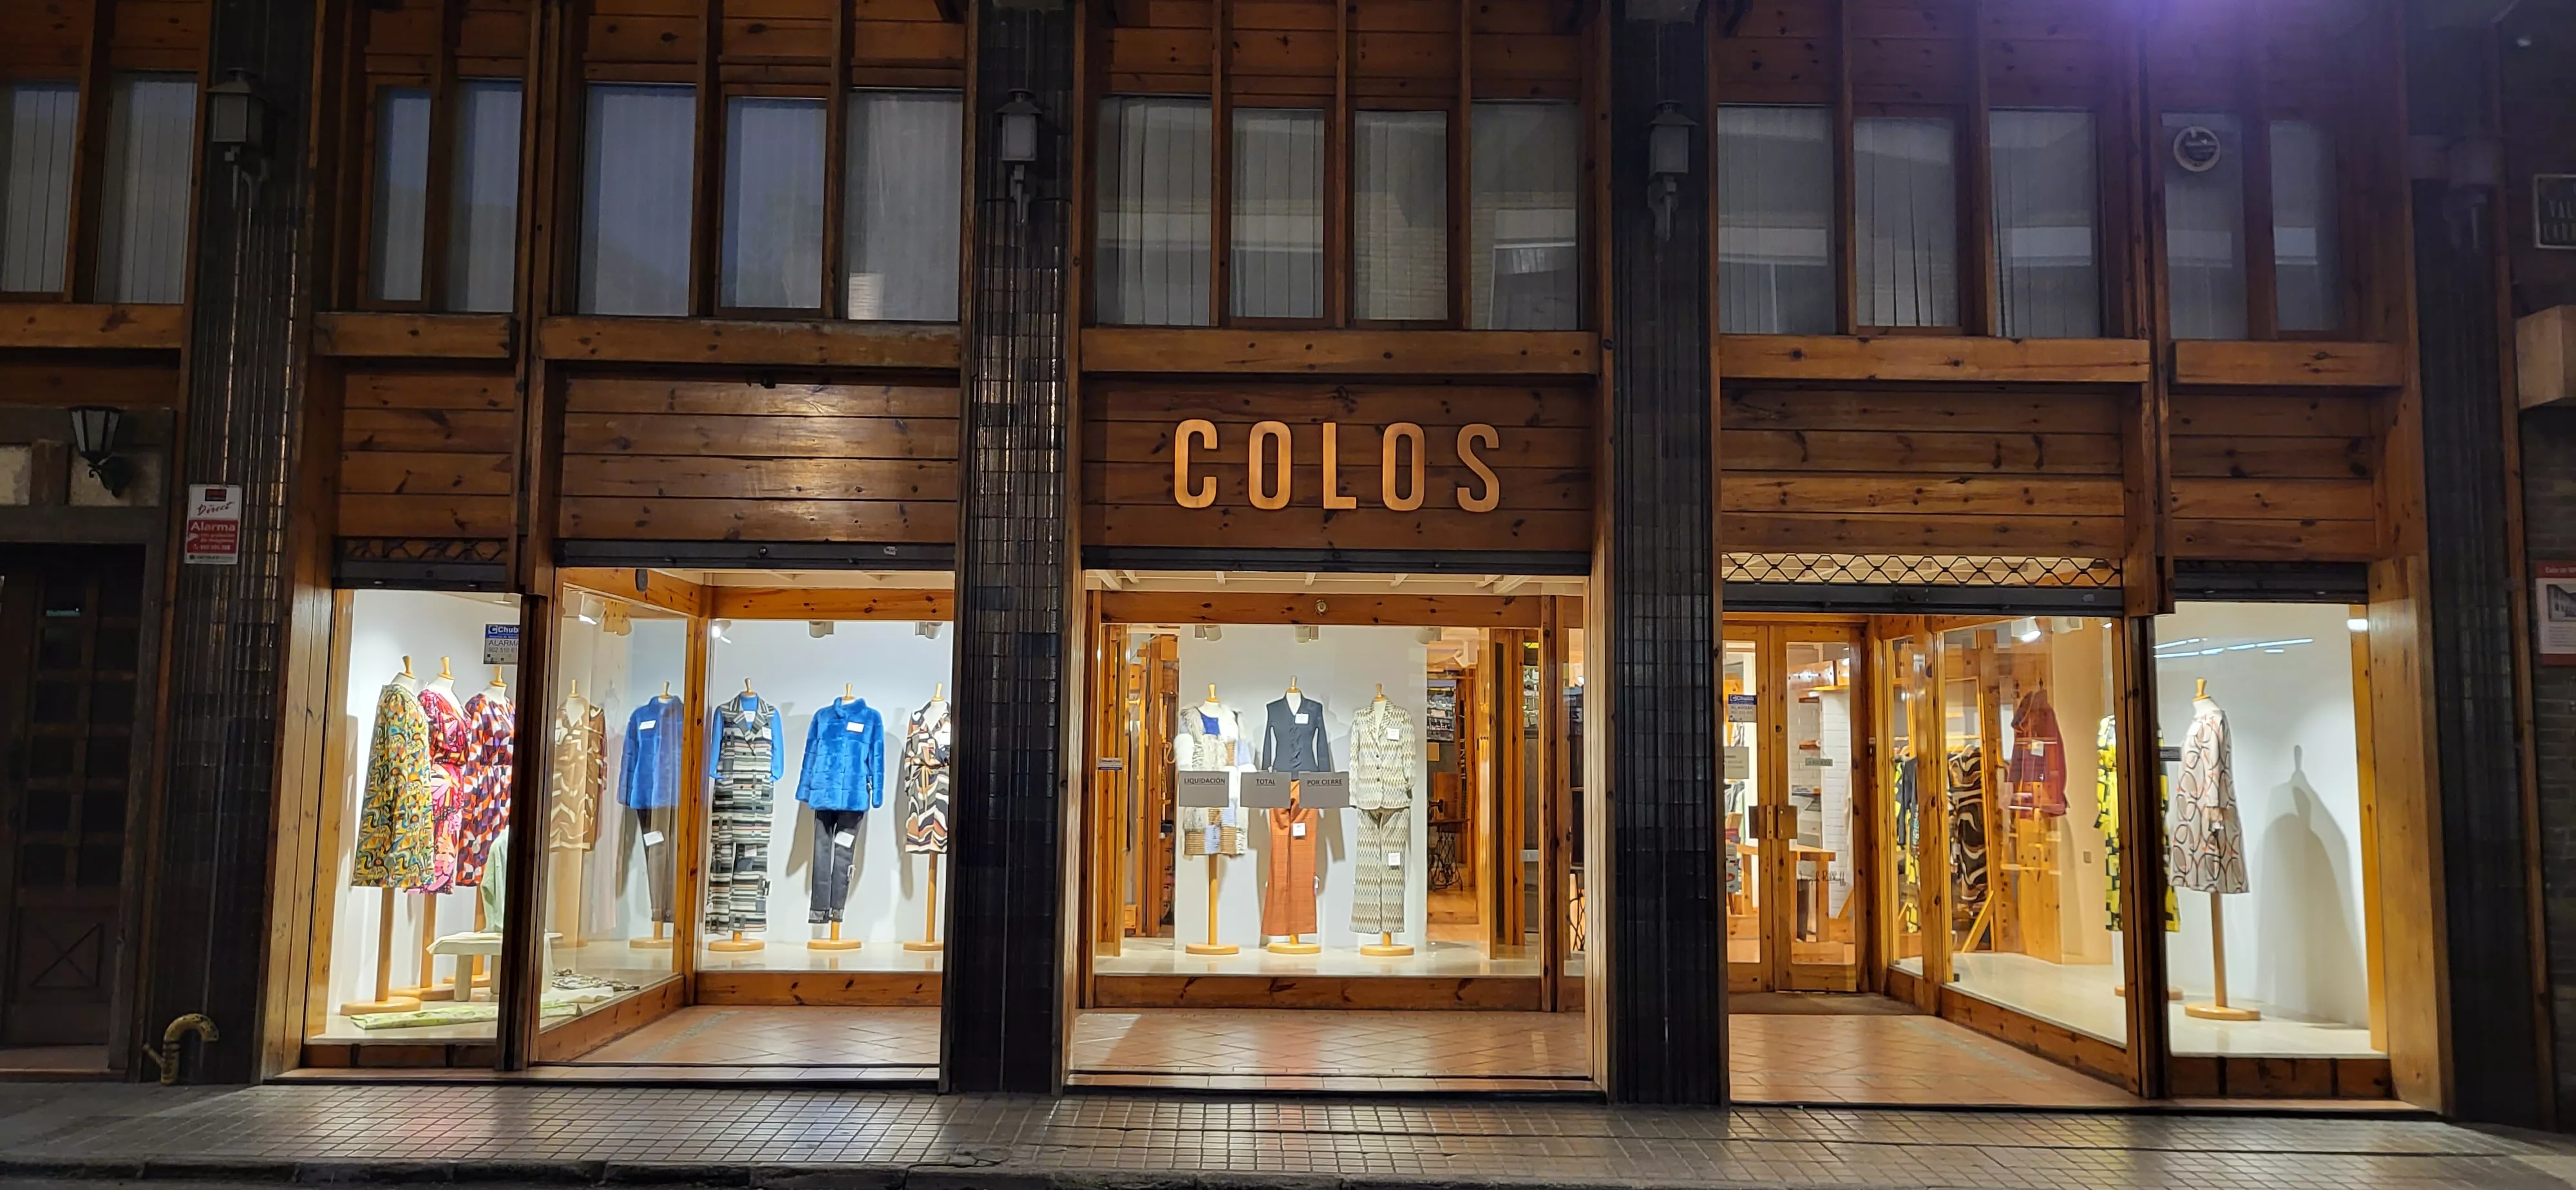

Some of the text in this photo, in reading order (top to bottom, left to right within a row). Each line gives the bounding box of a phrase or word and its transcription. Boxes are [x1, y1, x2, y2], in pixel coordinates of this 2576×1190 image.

[1173, 419, 1500, 513] COLOS
[197, 501, 234, 516] Direct
[190, 521, 236, 531] Alarma
[1184, 776, 1226, 784] LIQUIDACIÓN
